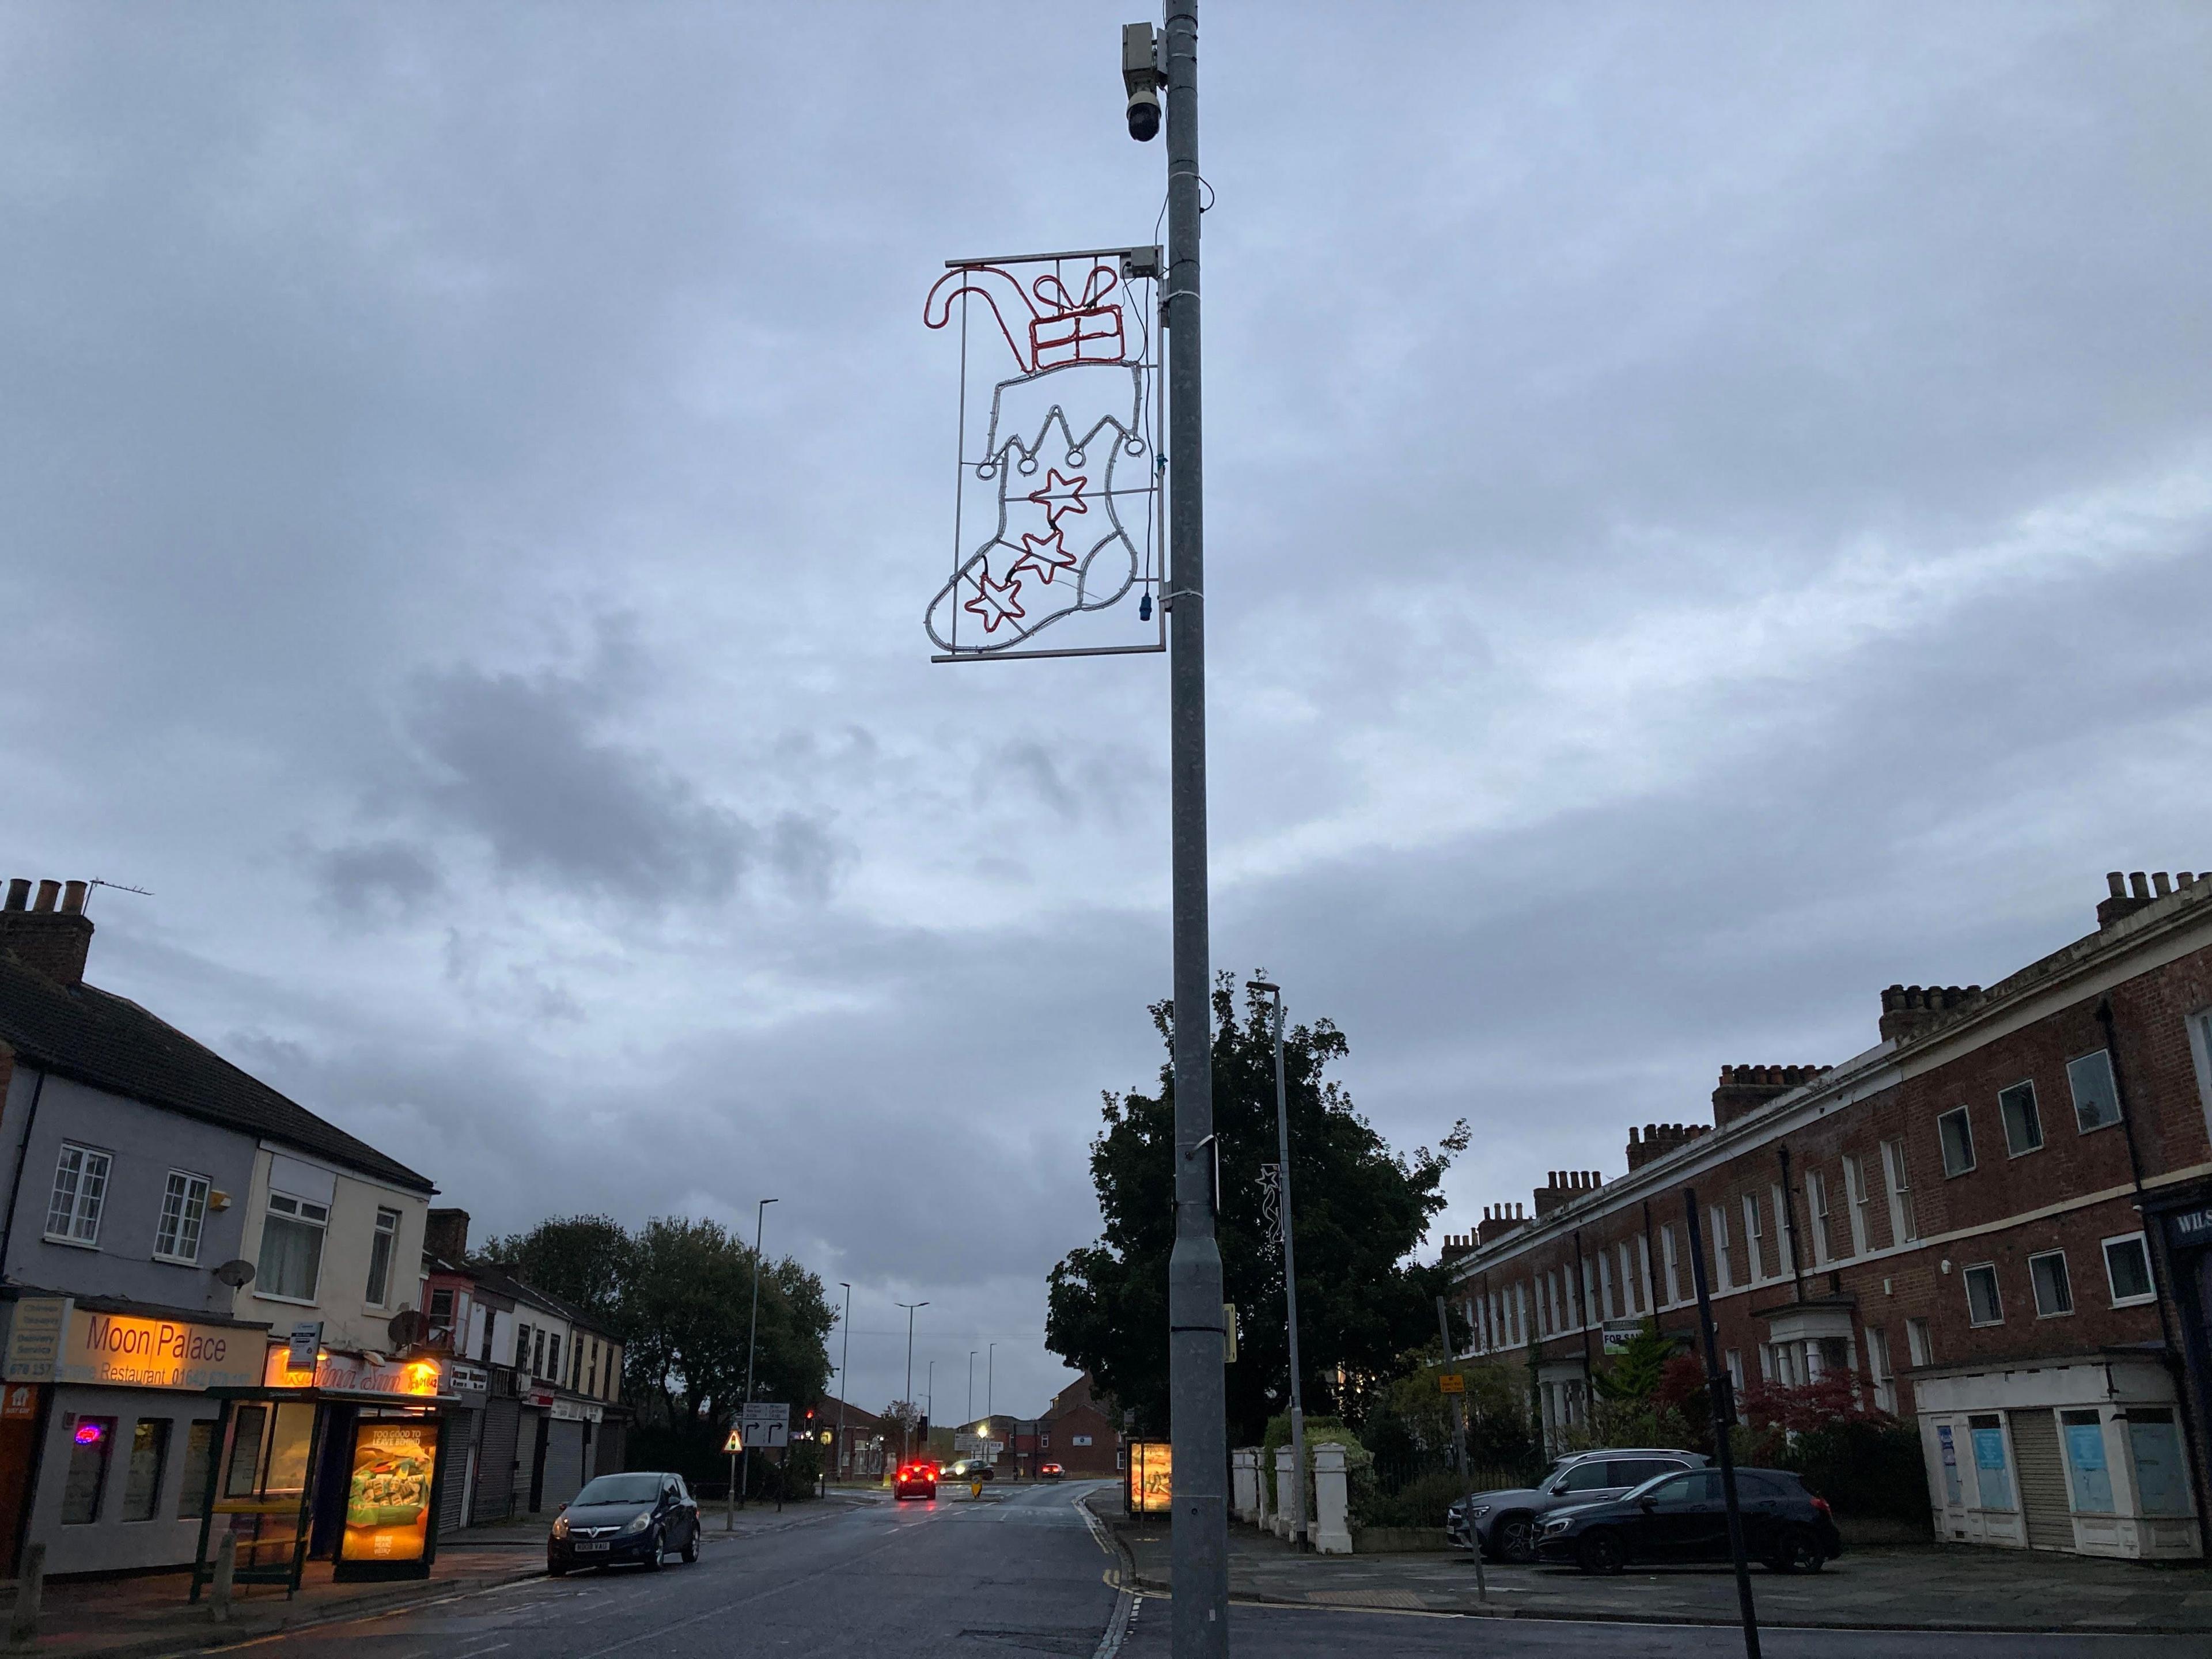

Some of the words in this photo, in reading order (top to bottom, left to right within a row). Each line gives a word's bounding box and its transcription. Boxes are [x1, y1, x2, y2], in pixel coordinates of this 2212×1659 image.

[86, 1316, 150, 1355] Moon
[156, 1324, 226, 1362] Palace
[1604, 1334, 1621, 1343] FOR
[101, 1362, 166, 1385] Restaurant
[373, 1430, 388, 1438] TOO
[389, 1430, 410, 1438] GOOD
[412, 1430, 421, 1438] TO
[373, 1438, 393, 1446] LEAVE
